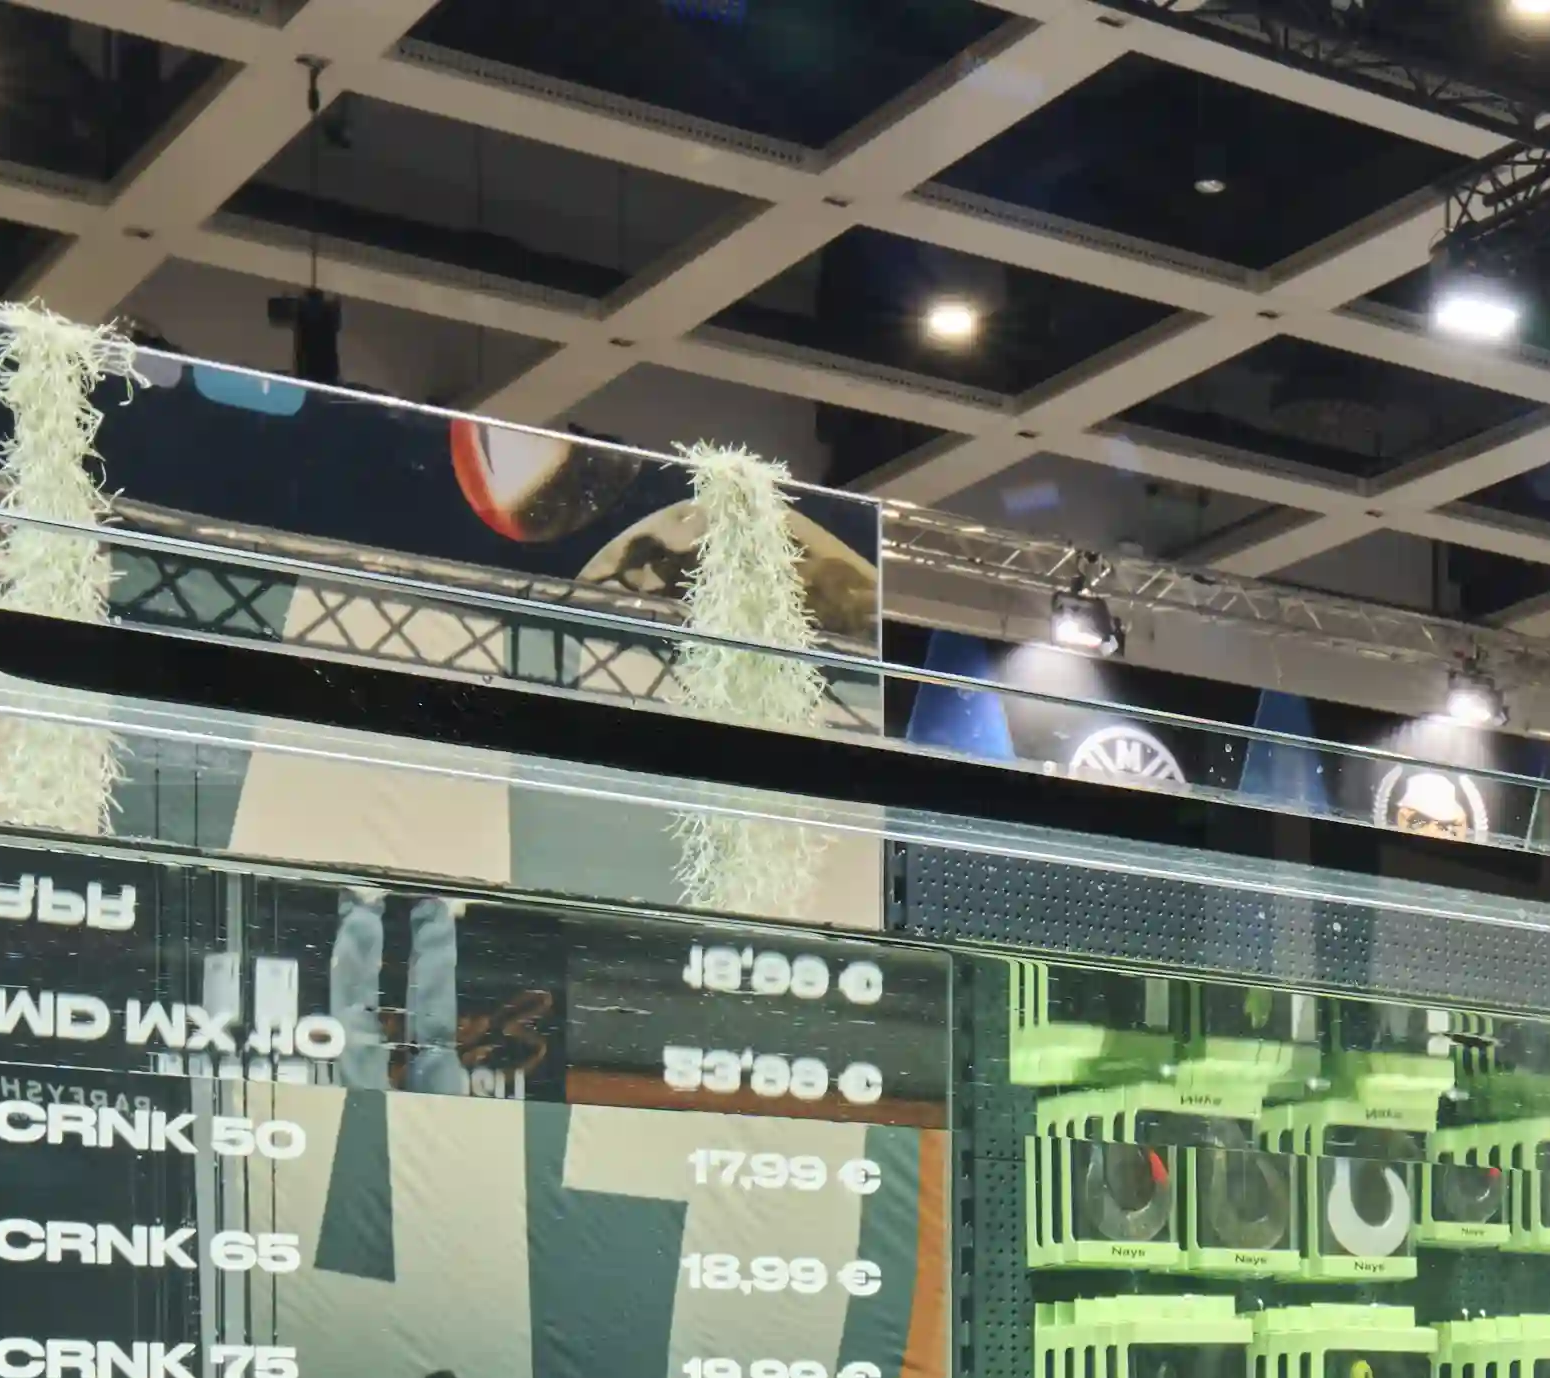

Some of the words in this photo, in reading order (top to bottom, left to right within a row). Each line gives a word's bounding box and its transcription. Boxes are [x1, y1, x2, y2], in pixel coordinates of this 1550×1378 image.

[212, 1117, 306, 1160] 50
[687, 1149, 827, 1192] 17,99
[837, 1159, 881, 1195] €
[210, 1232, 300, 1273] 65
[681, 1252, 827, 1295] 18,99
[837, 1259, 882, 1296] €
